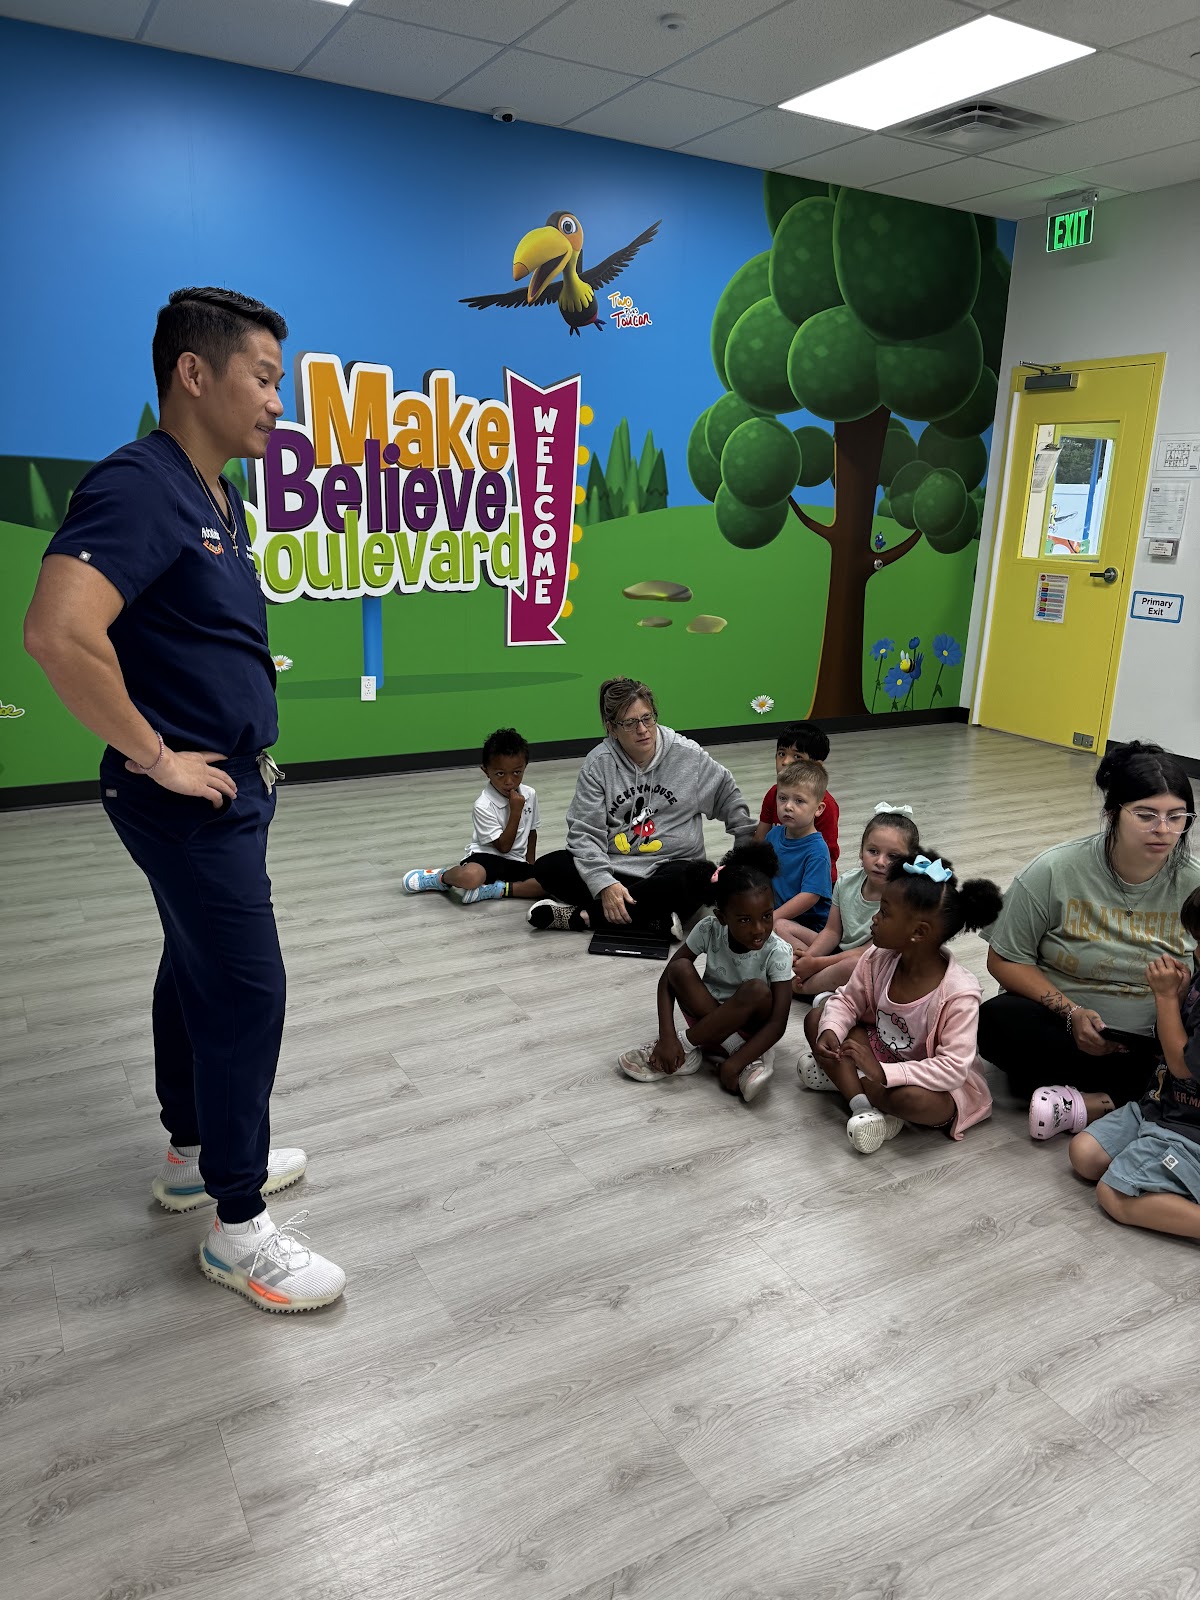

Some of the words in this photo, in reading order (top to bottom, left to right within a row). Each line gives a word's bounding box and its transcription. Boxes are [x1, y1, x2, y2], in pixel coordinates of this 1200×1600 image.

[1054, 209, 1089, 249] EXIT
[608, 292, 633, 308] Two
[308, 361, 511, 472] Make
[264, 429, 508, 534] Believe
[532, 405, 559, 605] WELCOME
[1141, 597, 1174, 609] Primary
[1147, 607, 1164, 616] Exit
[608, 784, 644, 818] MICKEY
